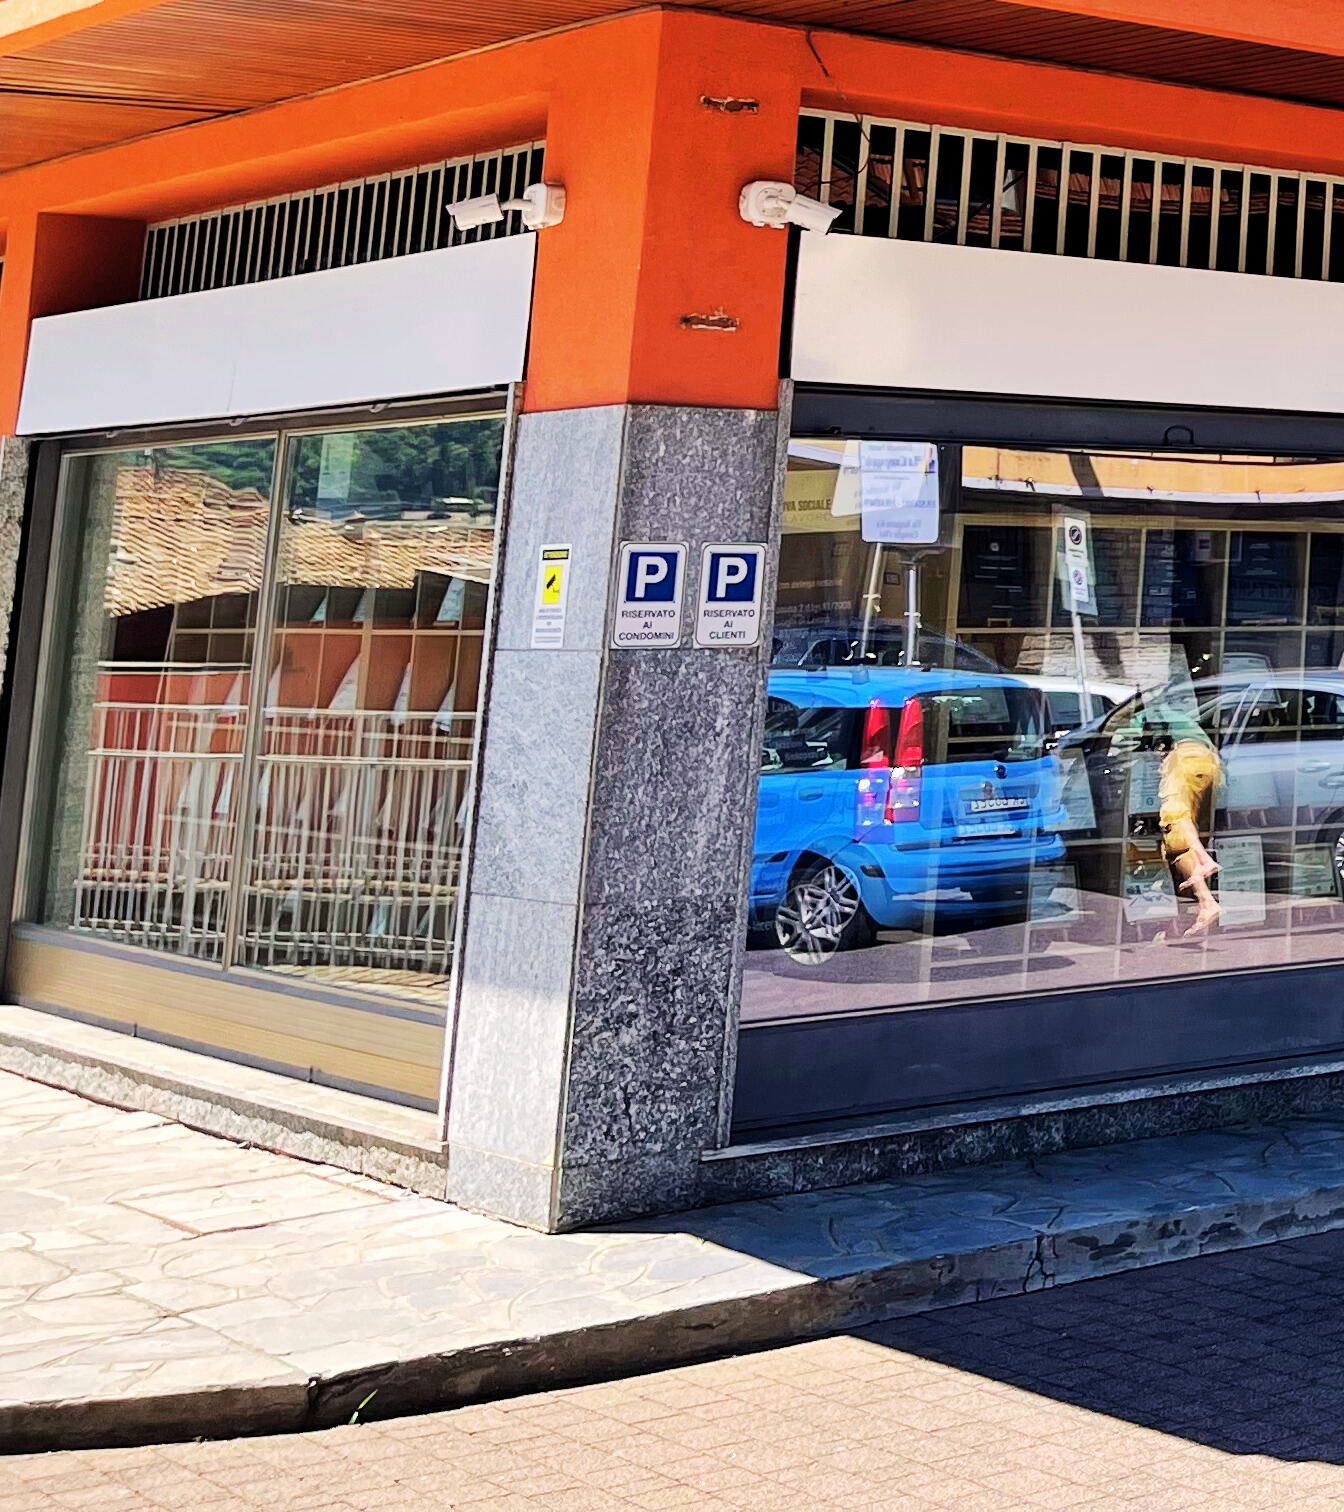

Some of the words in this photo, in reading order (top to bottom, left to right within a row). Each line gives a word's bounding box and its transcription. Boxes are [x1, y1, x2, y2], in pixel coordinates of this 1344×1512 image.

[634, 555, 669, 598] P
[716, 556, 749, 598] P
[621, 609, 676, 619] RISERVATO
[703, 609, 756, 618] RISERVATO
[618, 632, 675, 641] CONDOMINI
[709, 630, 746, 639] CLIENTI
